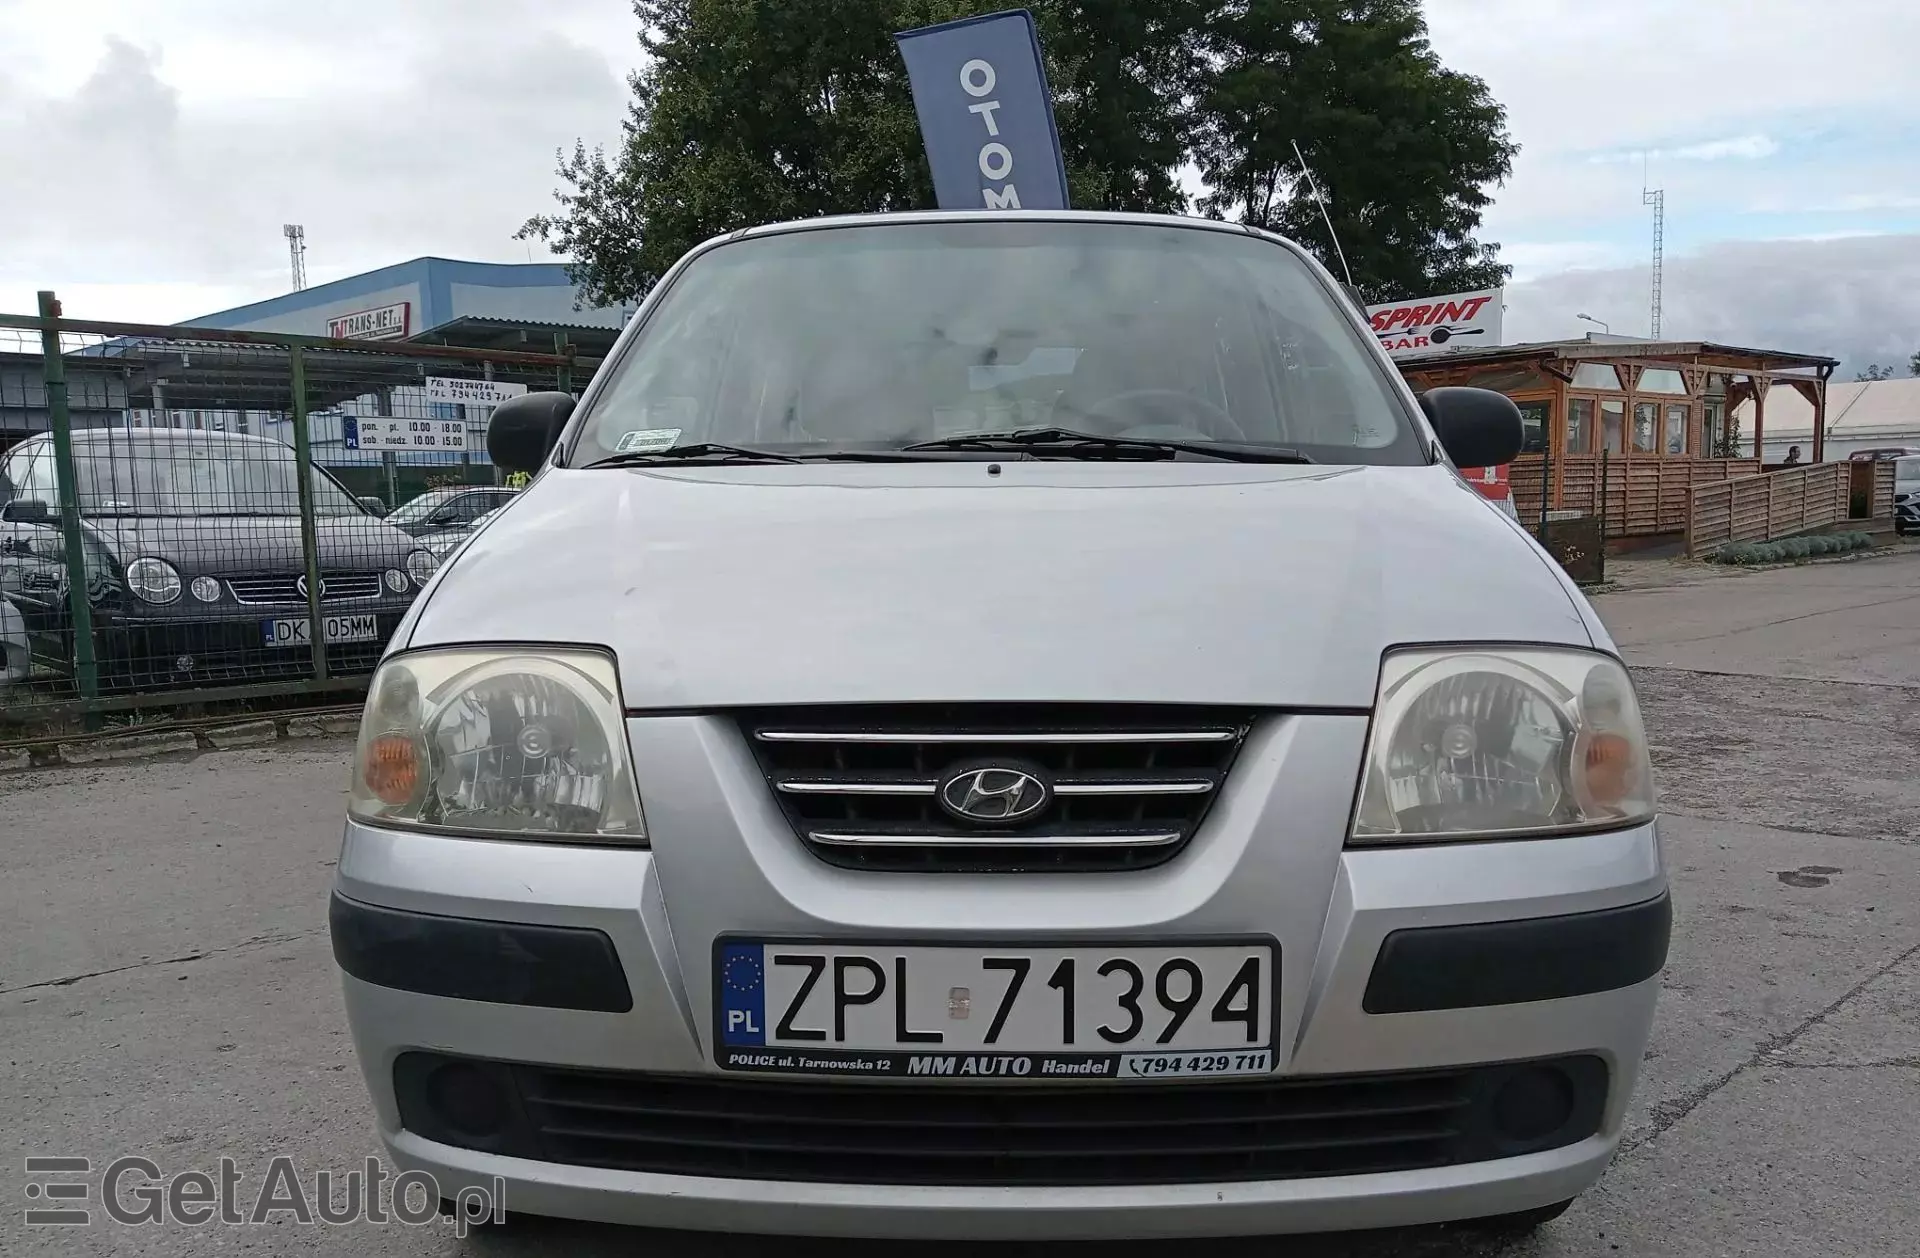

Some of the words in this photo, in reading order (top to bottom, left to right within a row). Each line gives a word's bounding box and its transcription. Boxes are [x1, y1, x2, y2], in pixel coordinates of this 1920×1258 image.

[1370, 296, 1492, 331] SPRINT
[1380, 336, 1428, 350] BAR
[408, 422, 430, 432] 10.00
[441, 423, 462, 433] 18.00
[347, 438, 358, 447] PL
[413, 436, 435, 445] 10.00
[442, 437, 463, 446] 15.00
[774, 955, 943, 1043] ZPL
[983, 957, 1260, 1044] 71394
[728, 1010, 759, 1033] PL
[729, 1054, 775, 1066] POLICE
[778, 1055, 794, 1067] ul.
[798, 1057, 873, 1070] Tarnowska
[876, 1059, 891, 1071] 12
[907, 1056, 954, 1075] MM
[960, 1056, 1032, 1075] AUTO
[1042, 1059, 1111, 1074] Handel
[1142, 1056, 1183, 1073] 794
[1186, 1056, 1230, 1072] 429
[1235, 1054, 1267, 1070] 711
